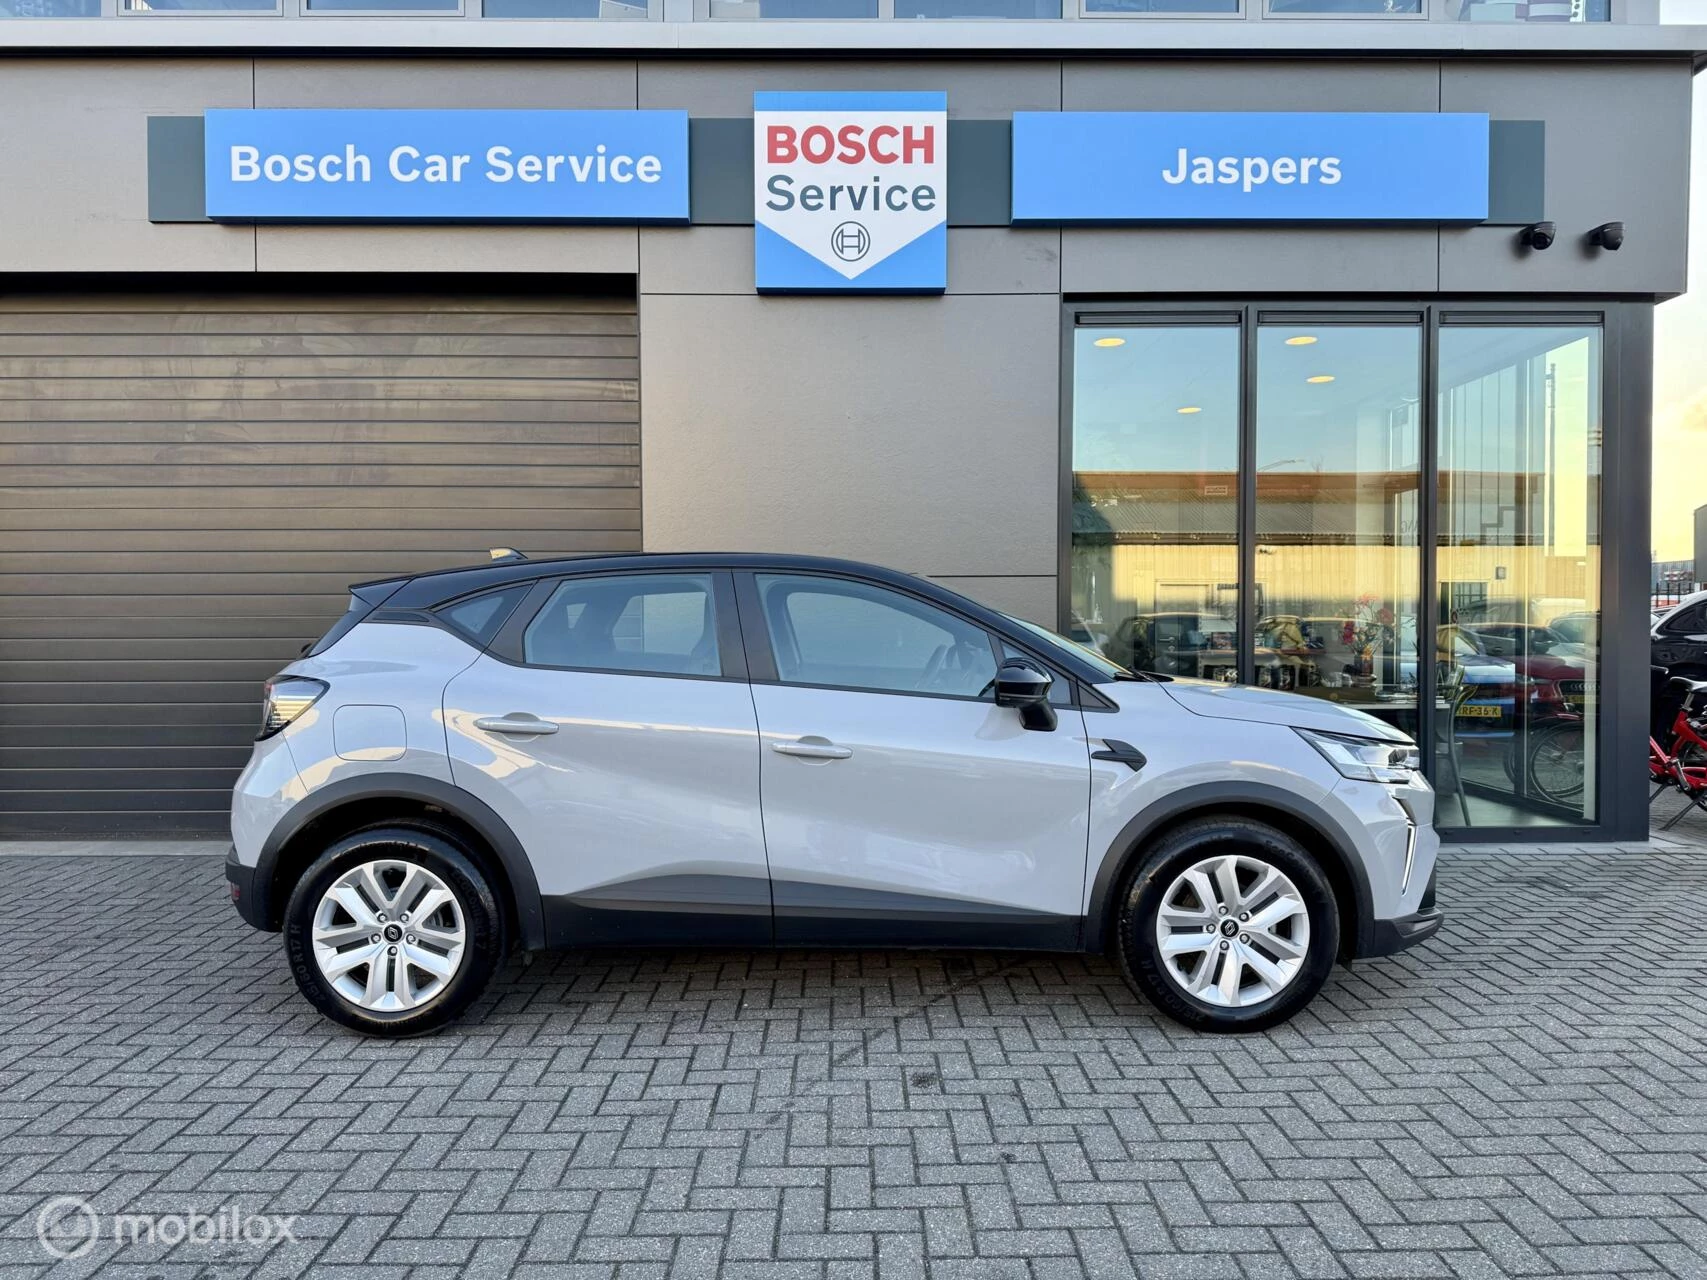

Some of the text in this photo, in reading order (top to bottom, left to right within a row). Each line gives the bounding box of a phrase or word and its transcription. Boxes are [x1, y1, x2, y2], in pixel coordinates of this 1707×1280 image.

[231, 144, 662, 183] Bosch Car Service
[767, 125, 935, 164] BOSCH
[1162, 148, 1342, 193] Jaspers
[766, 174, 936, 211] Service
[1458, 706, 1498, 716] RF-36-K
